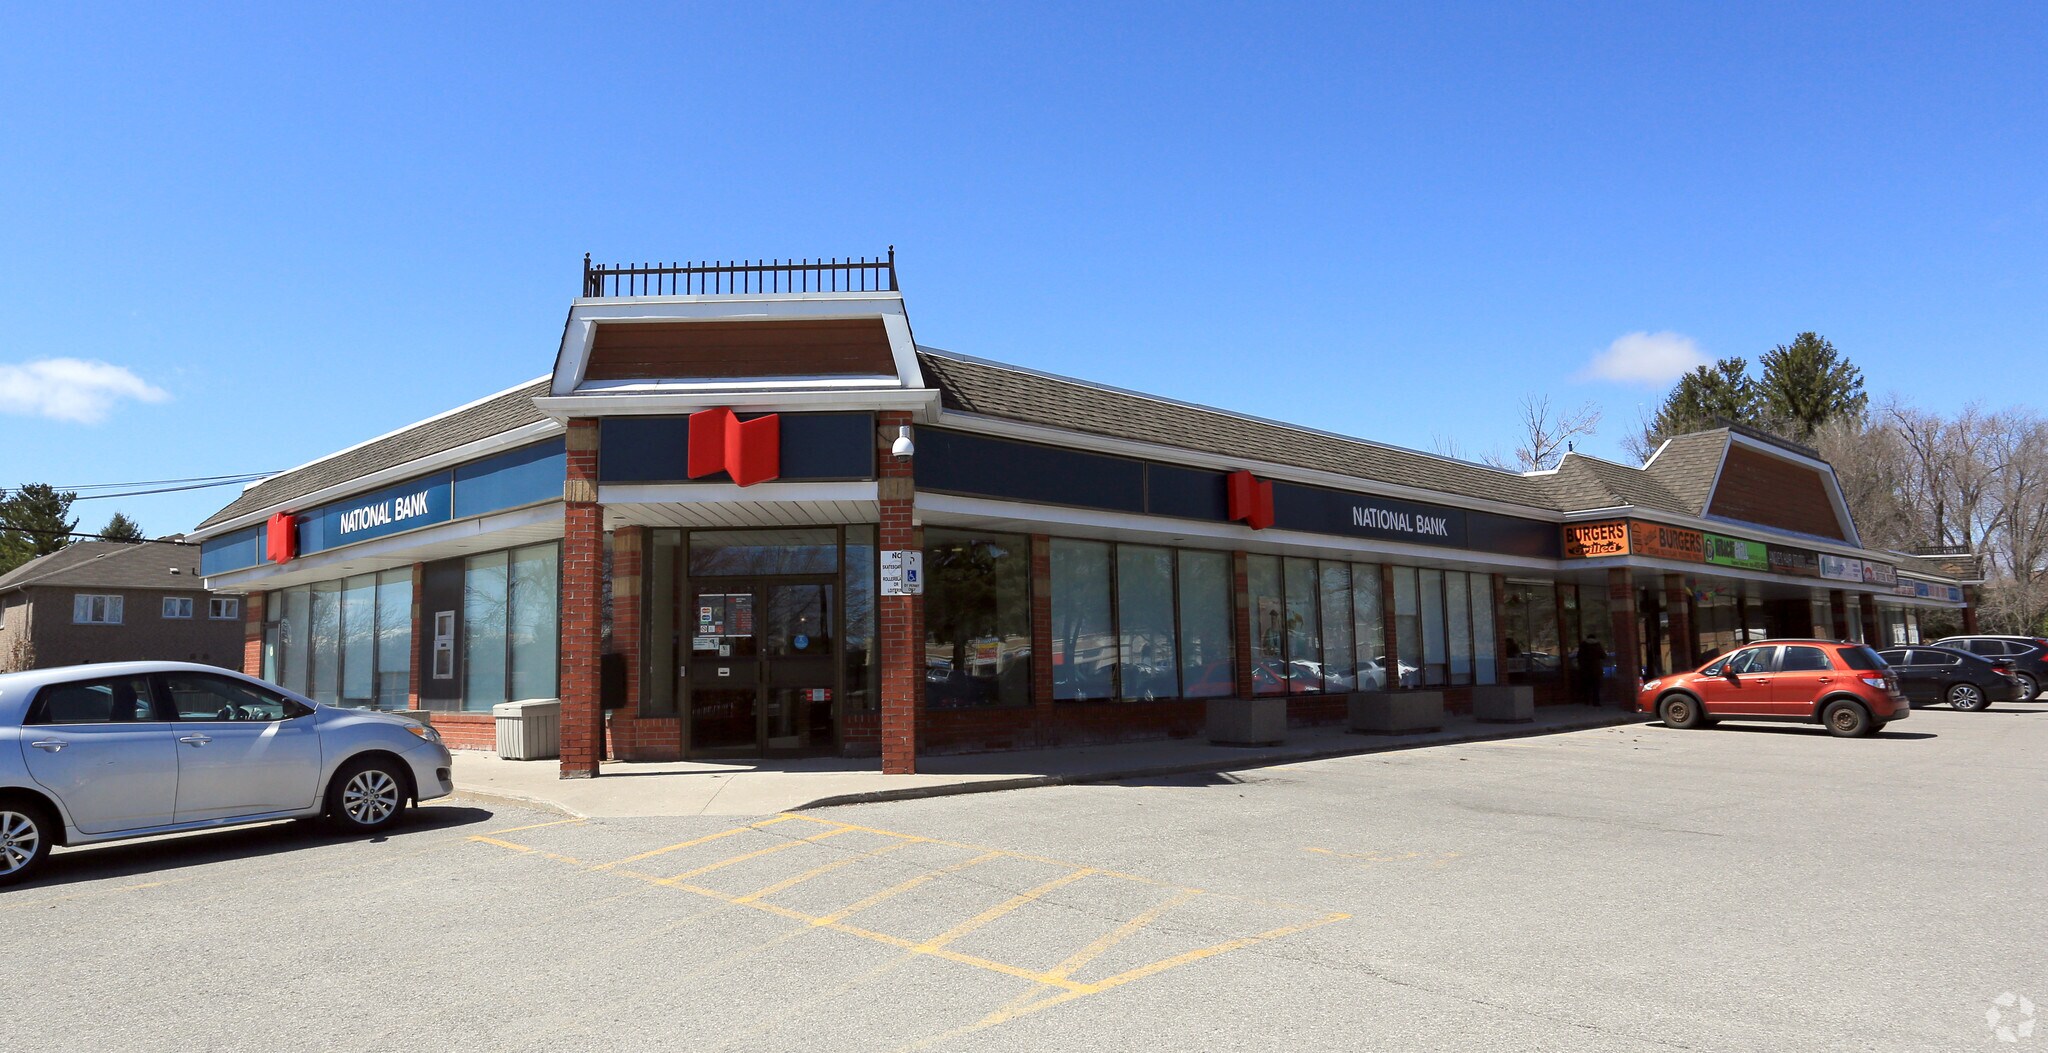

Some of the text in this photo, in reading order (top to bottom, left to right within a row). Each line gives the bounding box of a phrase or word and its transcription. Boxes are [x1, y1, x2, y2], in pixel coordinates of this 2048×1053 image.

[340, 490, 429, 535] NATIONAL BANK
[1352, 506, 1449, 537] NATIONAL BANK
[1566, 523, 1624, 542] BURGERS
[1659, 528, 1701, 553] BURGERS
